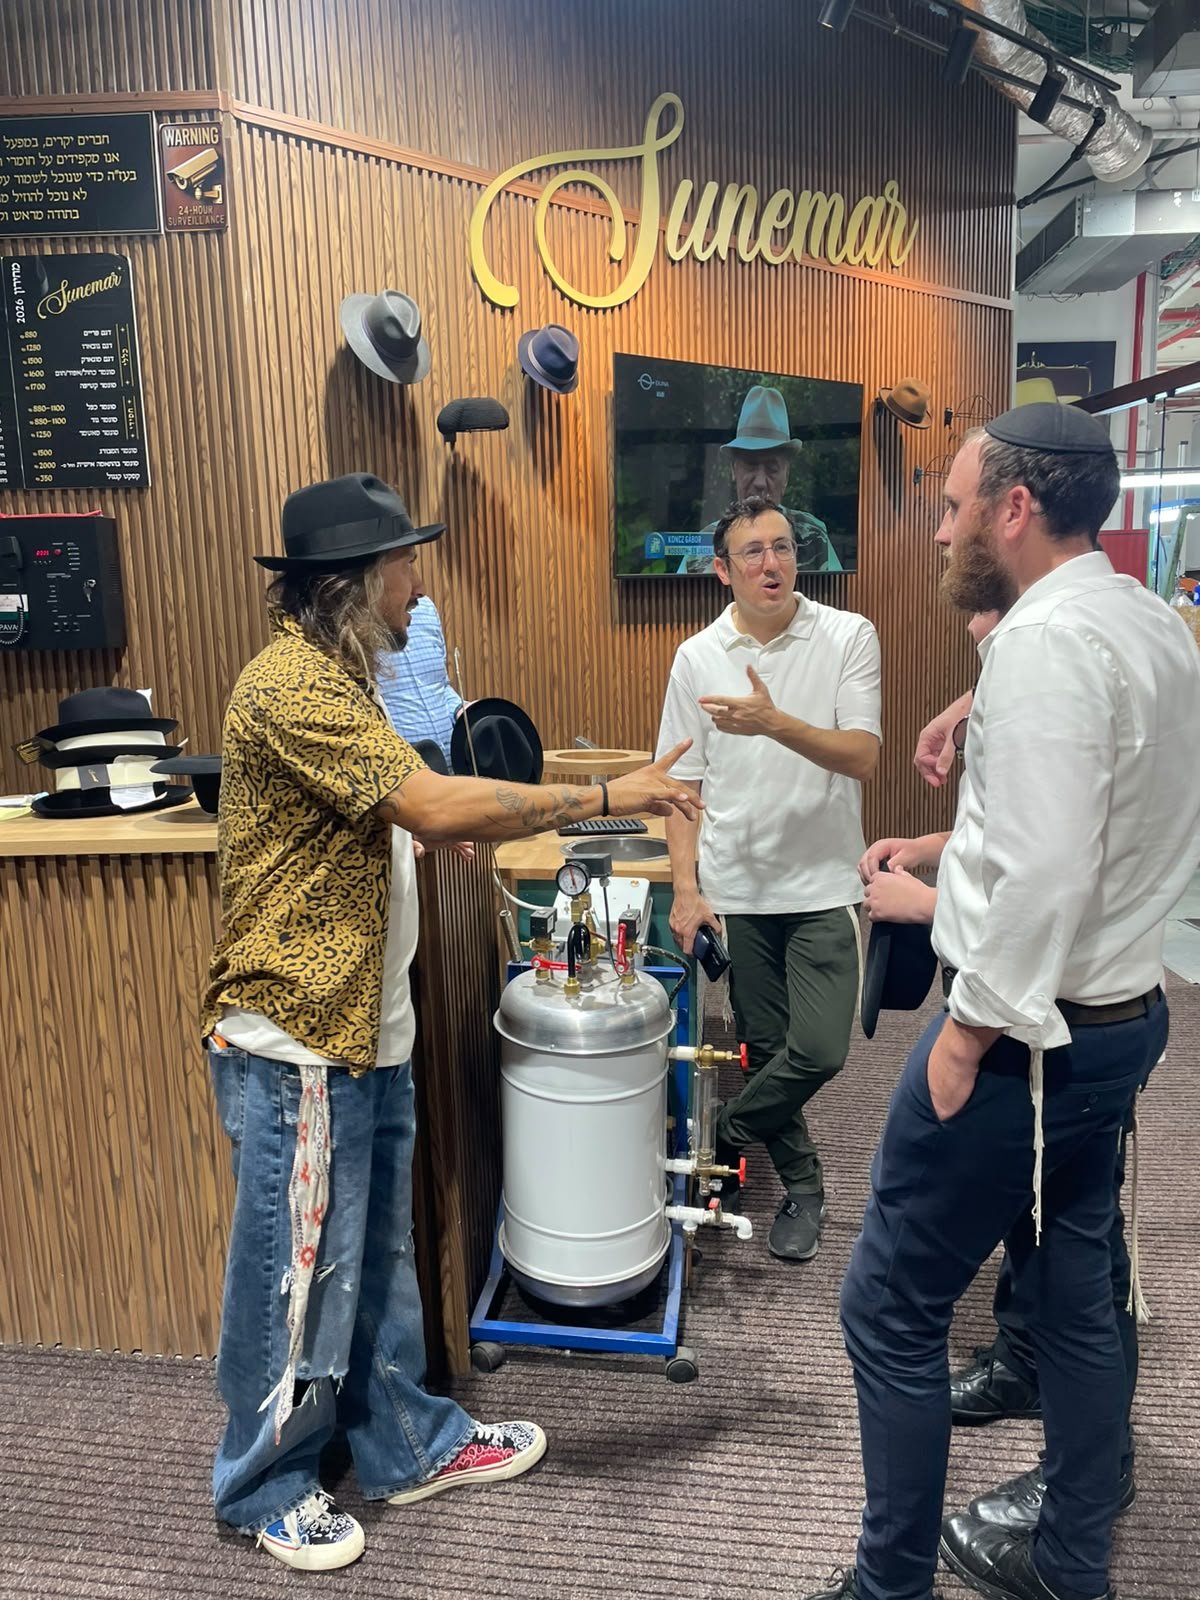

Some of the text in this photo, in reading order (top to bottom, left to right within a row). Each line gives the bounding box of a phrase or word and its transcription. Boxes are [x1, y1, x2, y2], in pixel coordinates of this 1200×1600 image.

[3, 135, 109, 149] חברים יקרים, במפעל
[164, 127, 218, 146] WARNING
[6, 156, 35, 166] חומרי
[38, 152, 53, 166] על
[57, 154, 99, 166] מקפידים
[104, 152, 119, 162] אנו
[14, 170, 48, 184] לשמור
[51, 170, 82, 182] שנוכל
[86, 171, 104, 182] כדי
[12, 189, 43, 202] להוזיל
[47, 188, 68, 201] נוכל
[73, 188, 87, 201] לא
[470, 92, 918, 308] Sunemar
[12, 210, 43, 221] מראש
[48, 209, 79, 219] בתודה
[178, 206, 213, 215] 24-HOUR
[168, 215, 224, 226] SURVEILLANCE
[11, 263, 26, 324] מחירון 2026
[37, 272, 122, 319] Sunemar
